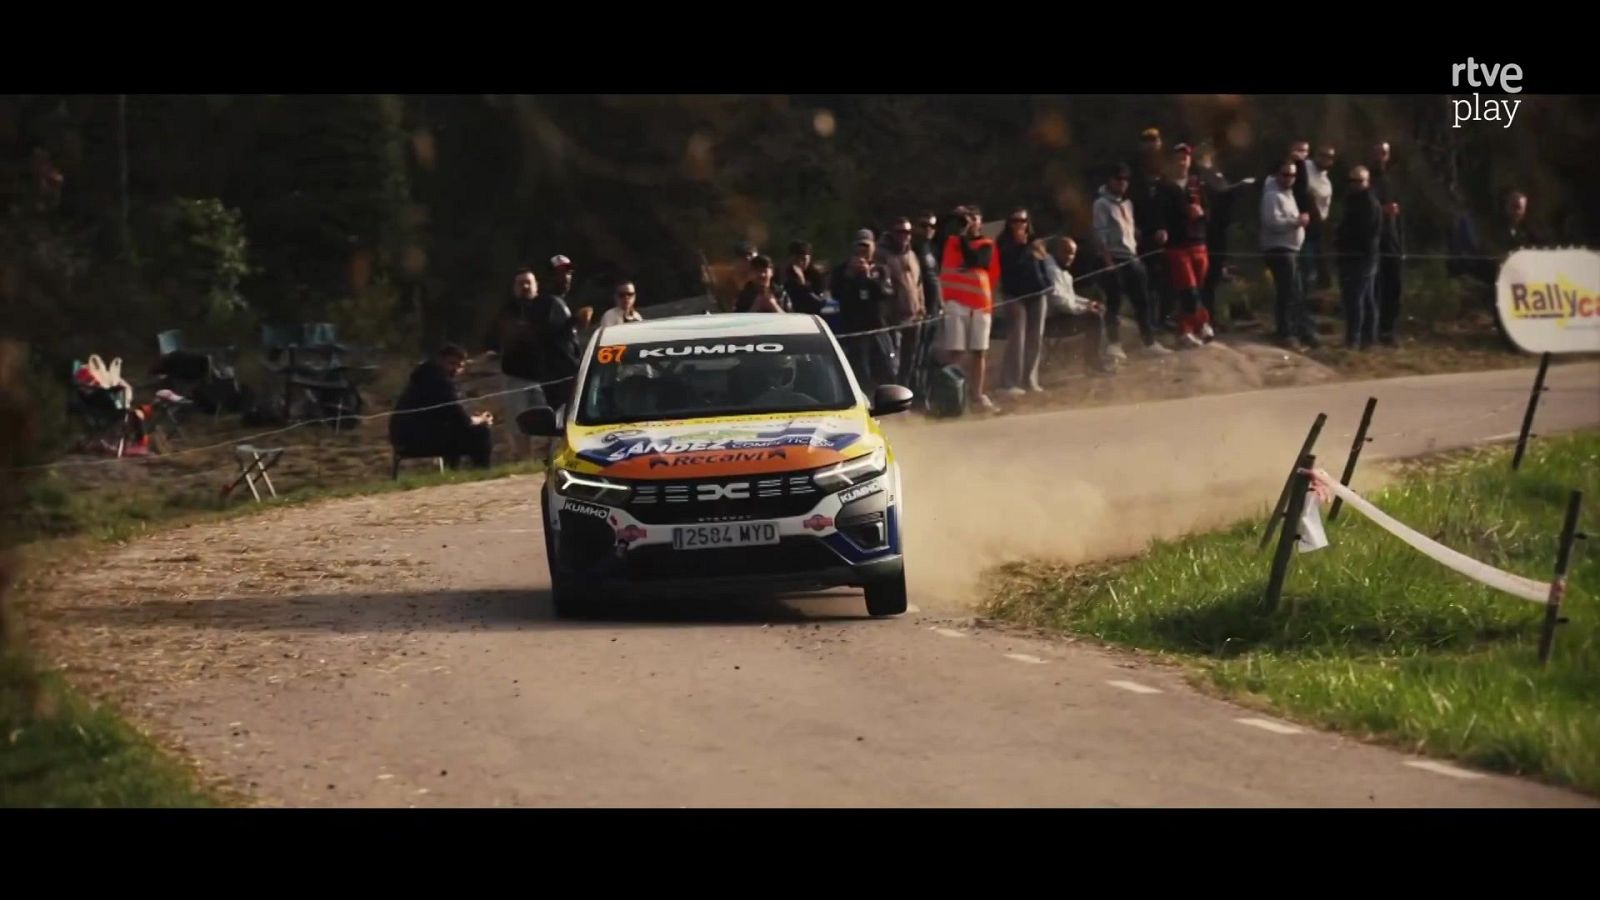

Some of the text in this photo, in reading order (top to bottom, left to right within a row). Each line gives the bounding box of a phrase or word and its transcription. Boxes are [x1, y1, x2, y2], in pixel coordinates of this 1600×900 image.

[597, 345, 627, 364] 67
[639, 342, 785, 359] KUMHO
[839, 481, 880, 503] KUMHO
[564, 501, 609, 519] KUMHO
[685, 523, 776, 546] 2584 MYD
